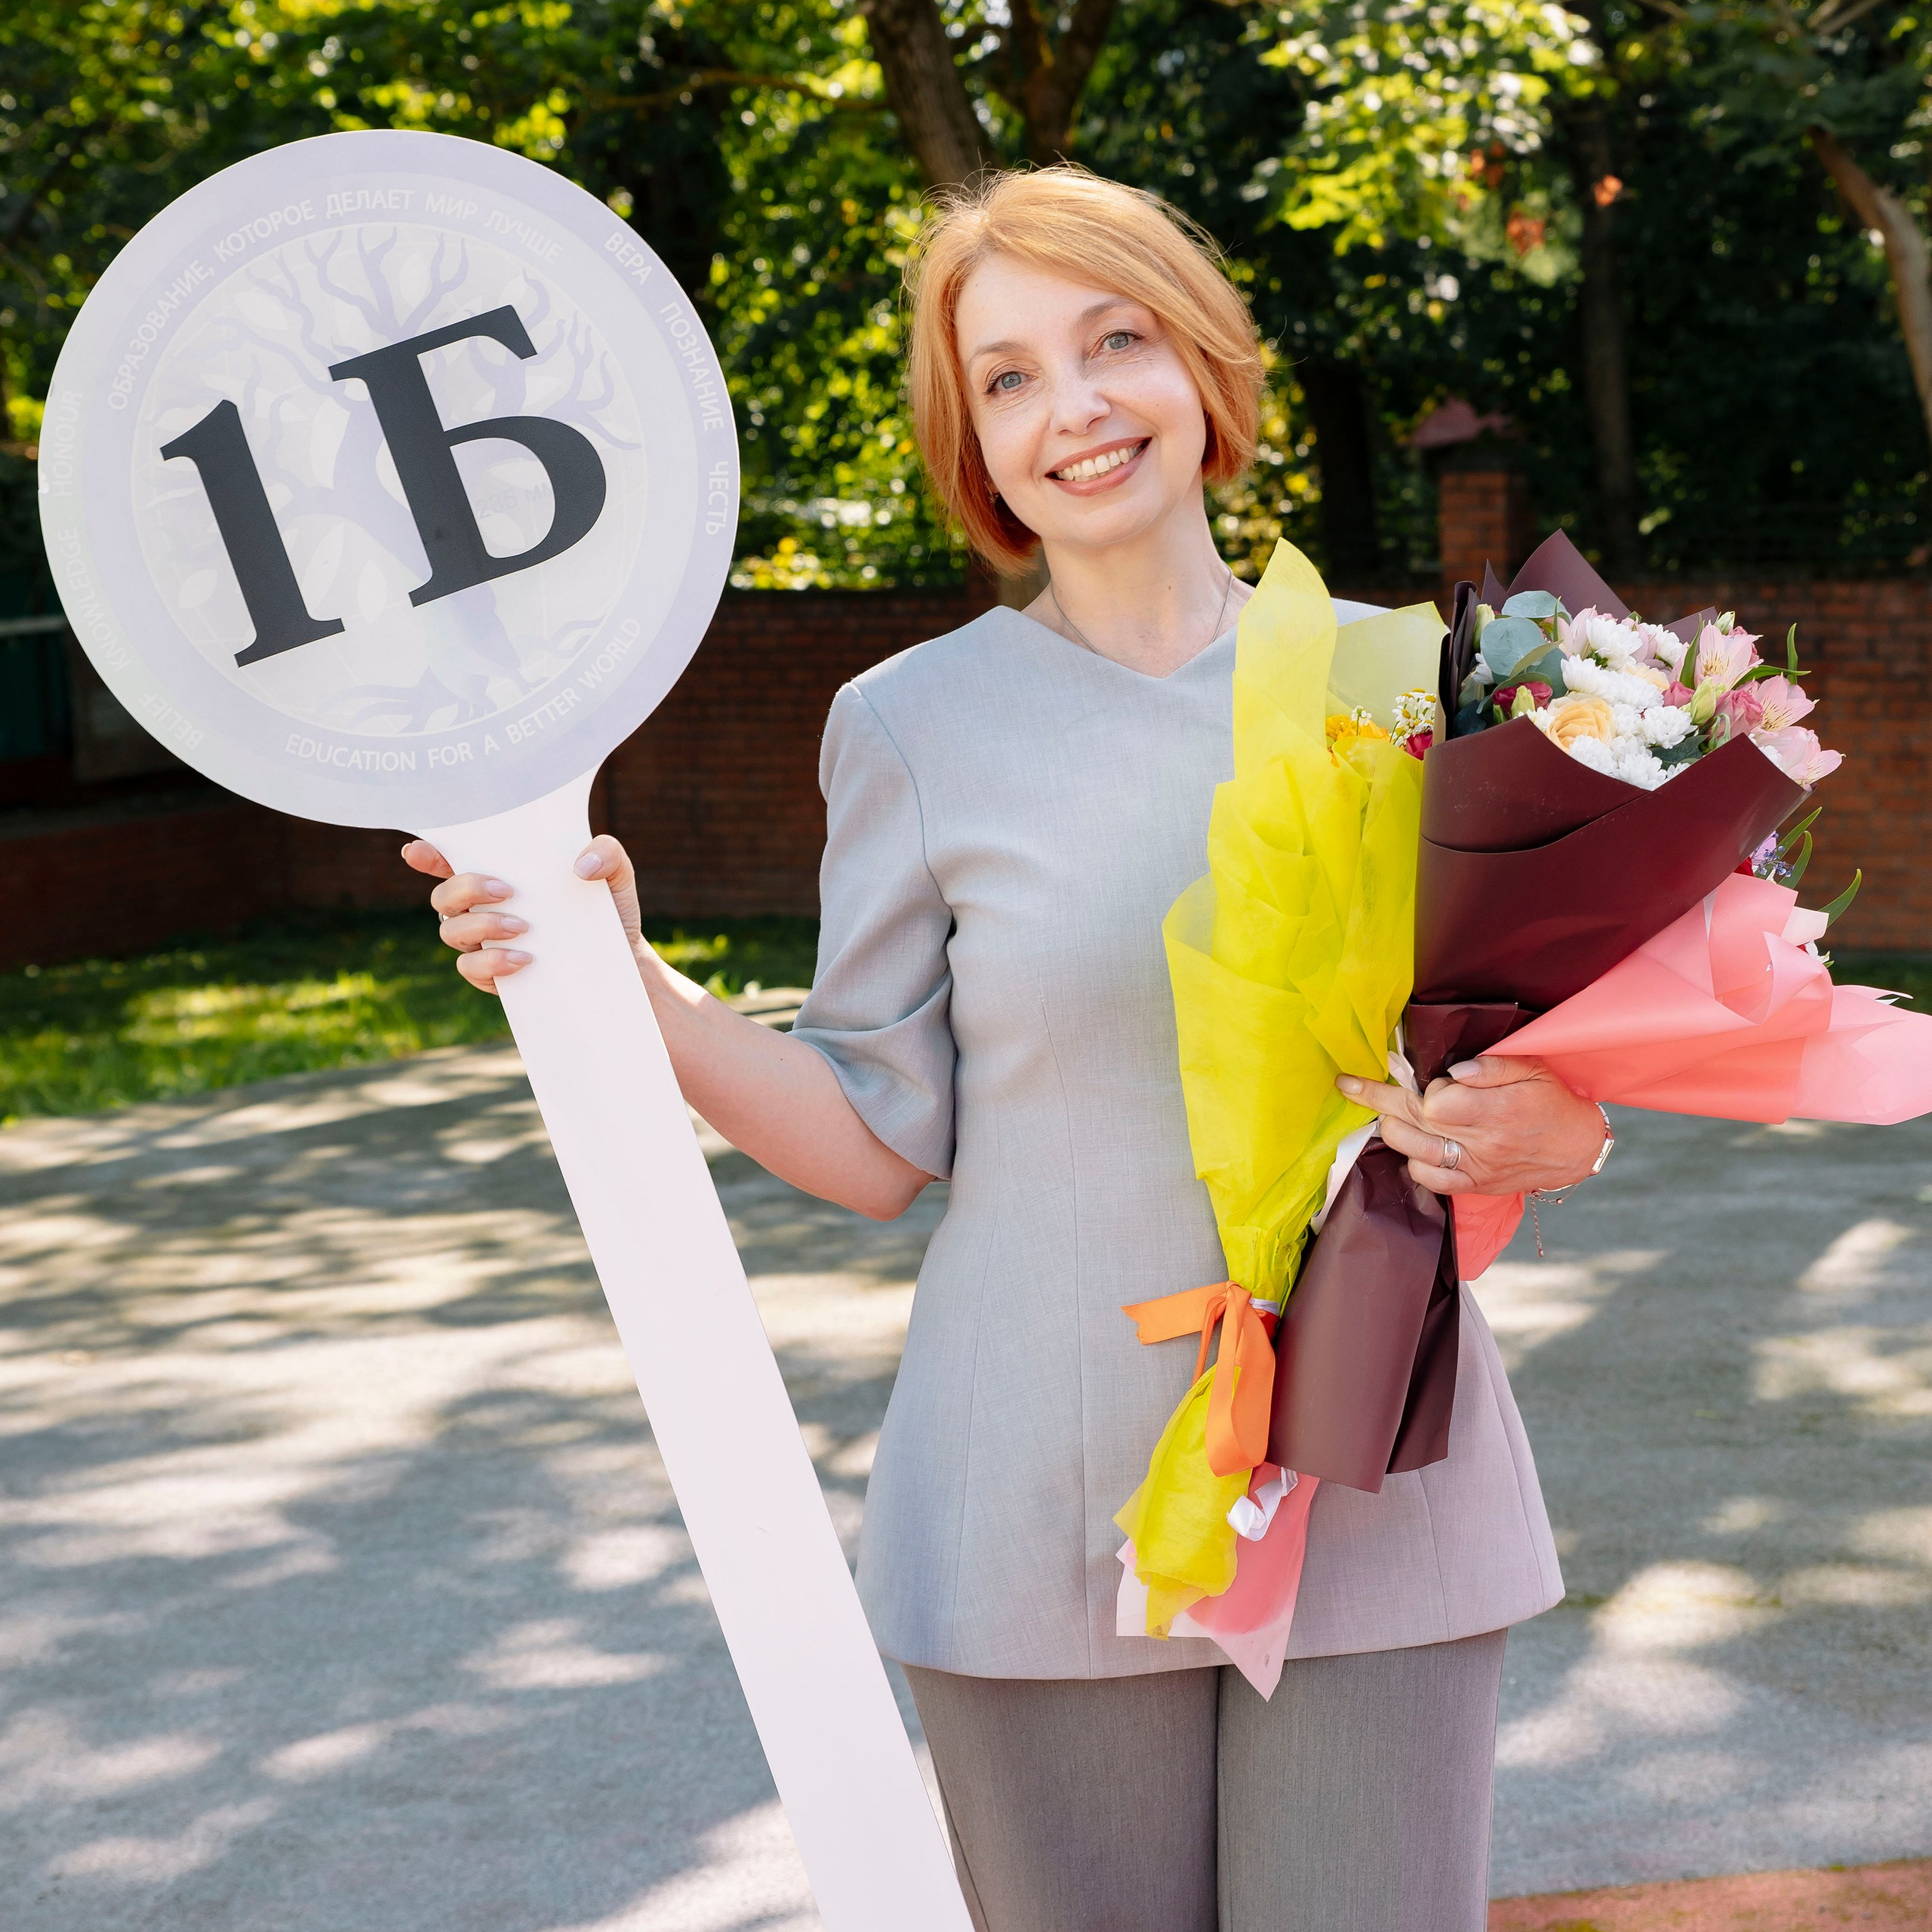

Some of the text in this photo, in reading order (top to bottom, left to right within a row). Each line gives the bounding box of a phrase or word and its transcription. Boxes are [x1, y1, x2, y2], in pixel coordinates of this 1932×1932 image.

[107, 189, 563, 411] ОБРАЗОВАНИЕ, КОТОРОЕ ДЕЛАЕТ МИР ЛУЧШЕ
[605, 232, 729, 535] ВЕРА ПОЗНАНИЕ ЧЕСТЬ
[53, 390, 204, 750] BELIEF KNOWLEDGE HONOUR
[285, 617, 641, 771] EDUCATION FOR A BETTER WORLD
